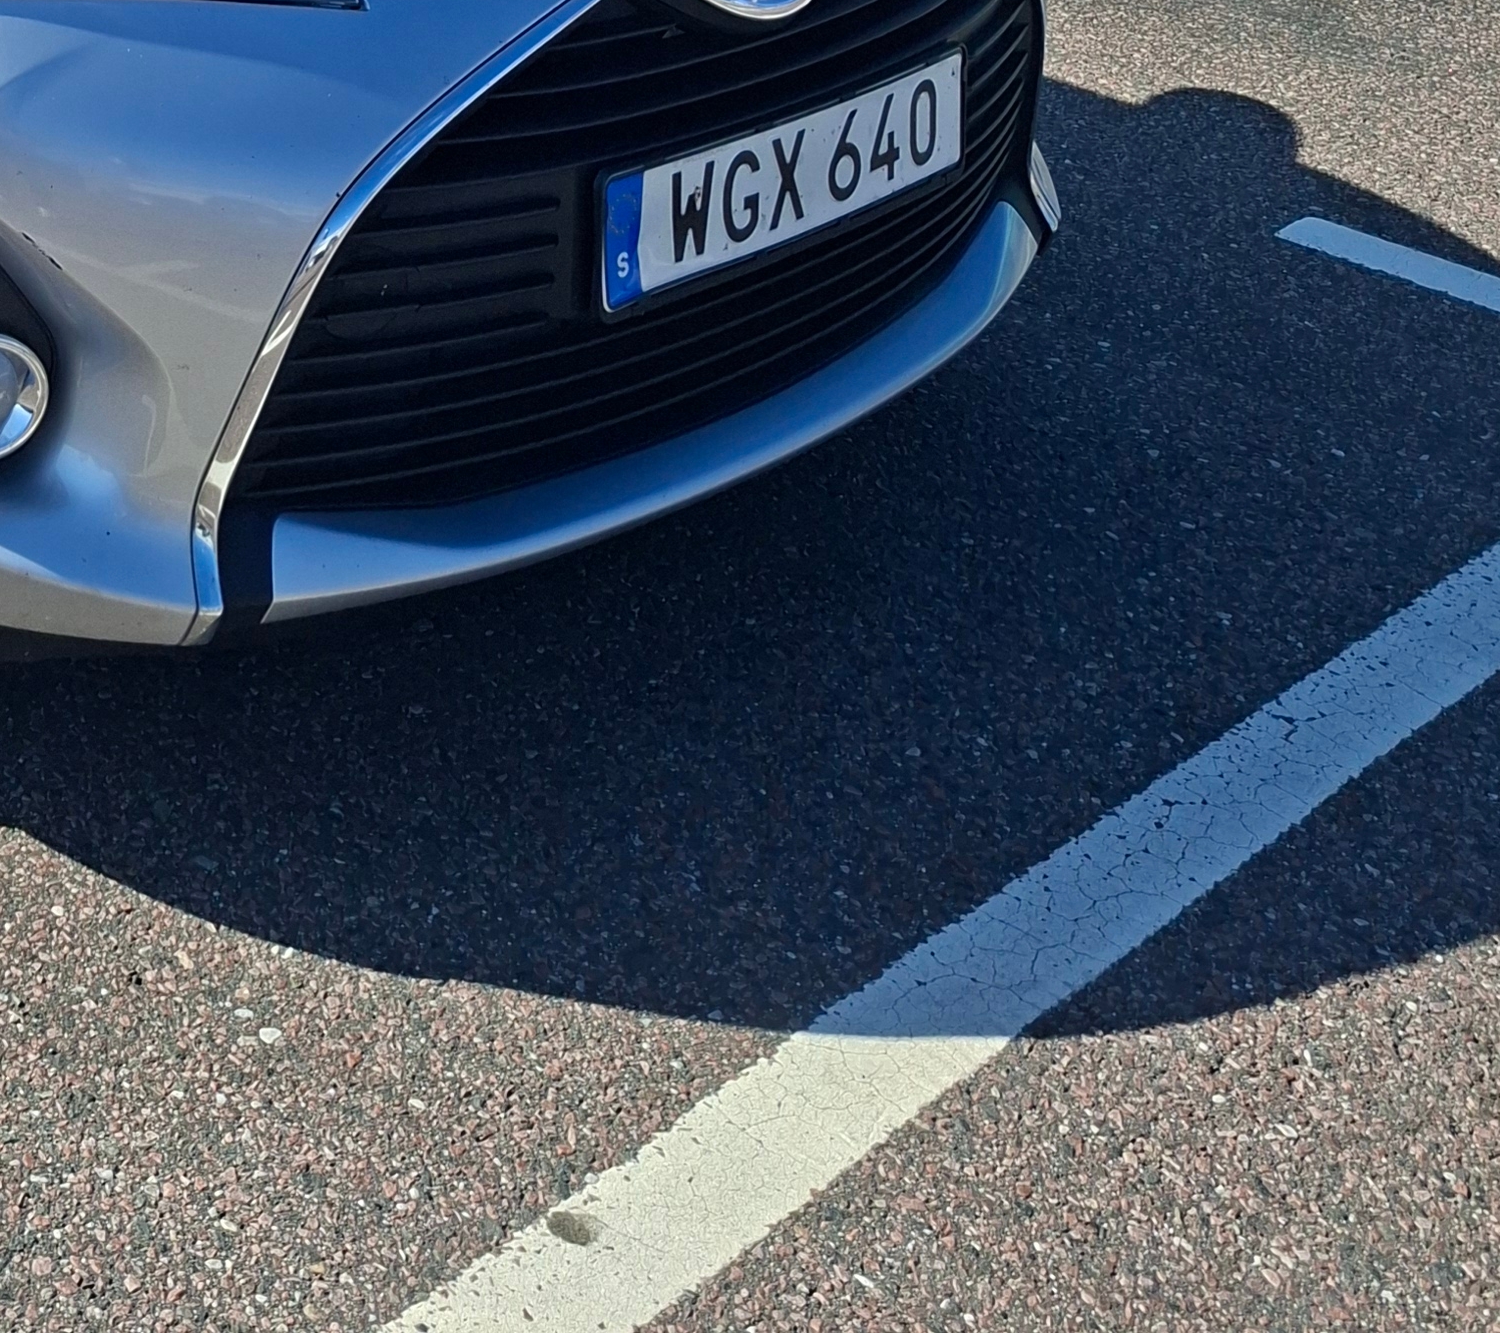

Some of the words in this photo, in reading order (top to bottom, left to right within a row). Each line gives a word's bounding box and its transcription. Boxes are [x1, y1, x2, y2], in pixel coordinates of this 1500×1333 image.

[671, 128, 806, 264] WGX
[827, 78, 937, 202] 640
[616, 251, 630, 278] S
